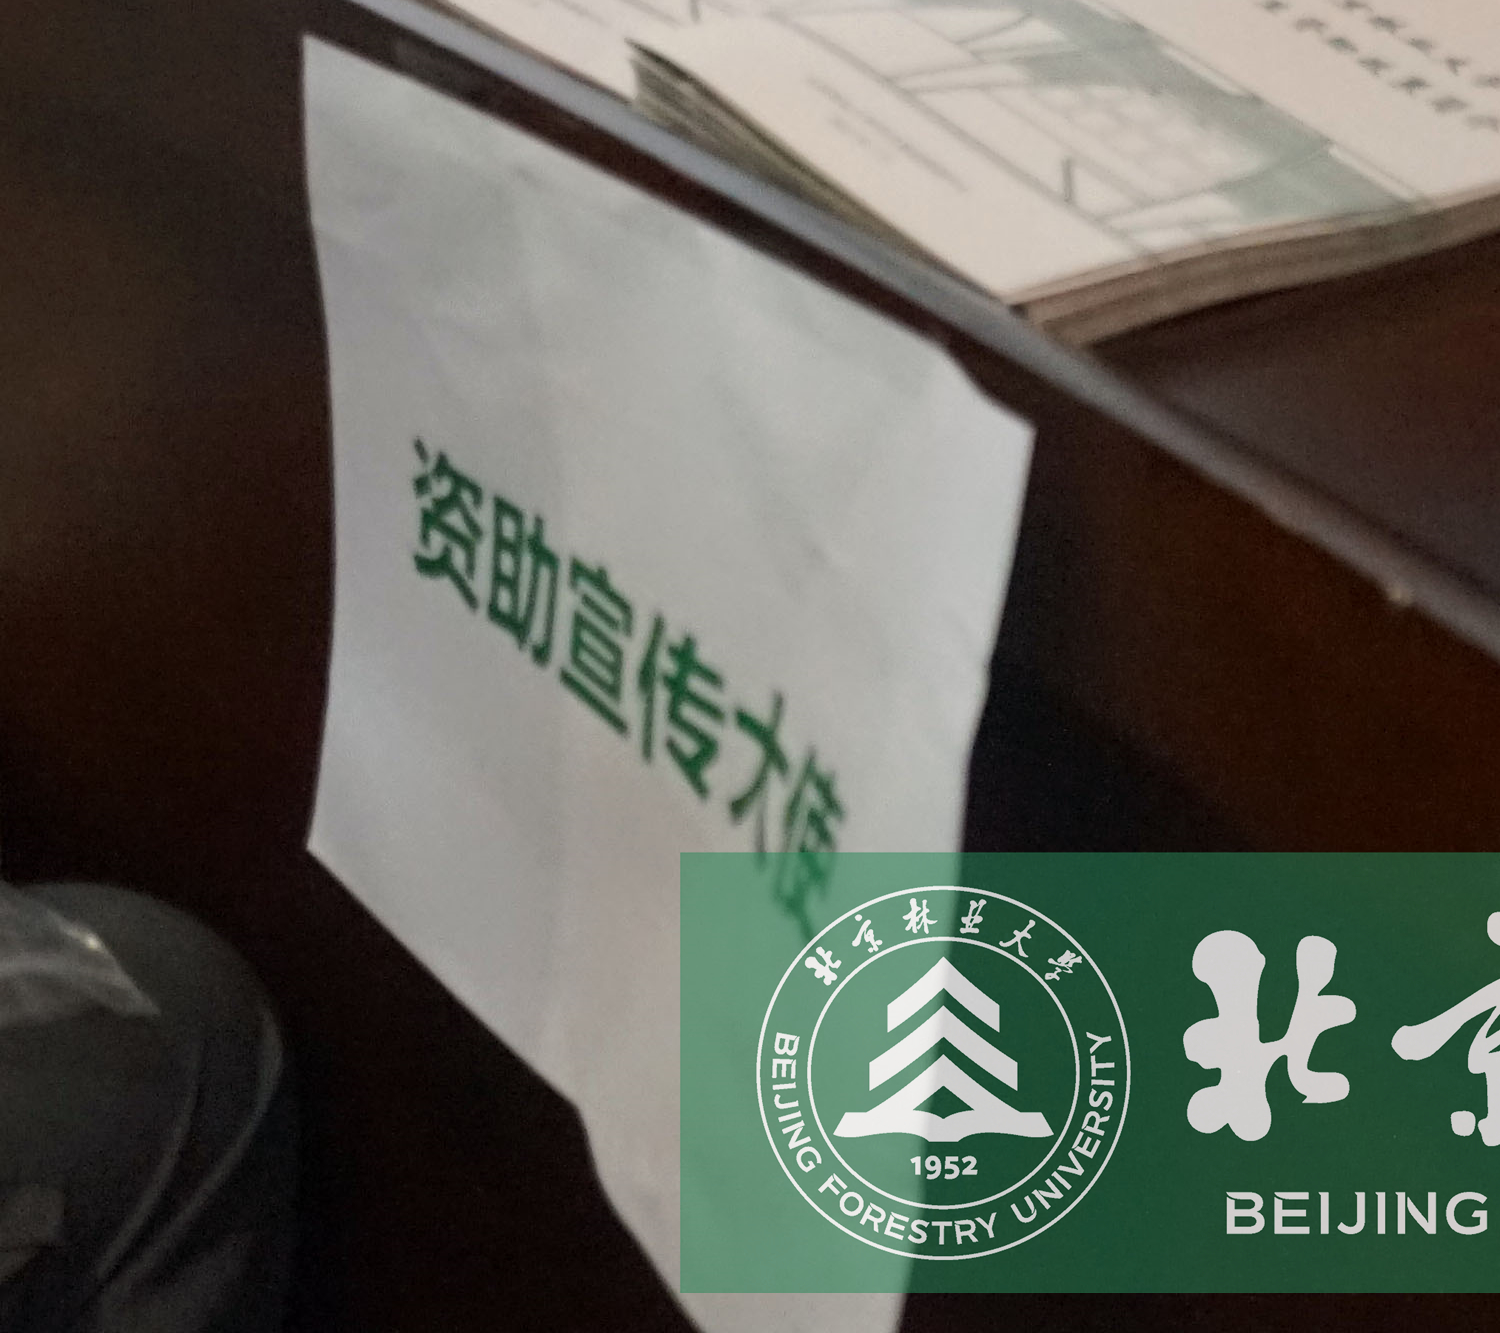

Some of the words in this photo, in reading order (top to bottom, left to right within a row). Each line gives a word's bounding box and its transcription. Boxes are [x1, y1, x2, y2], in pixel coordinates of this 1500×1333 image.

[413, 435, 846, 945] 资助宣传大使
